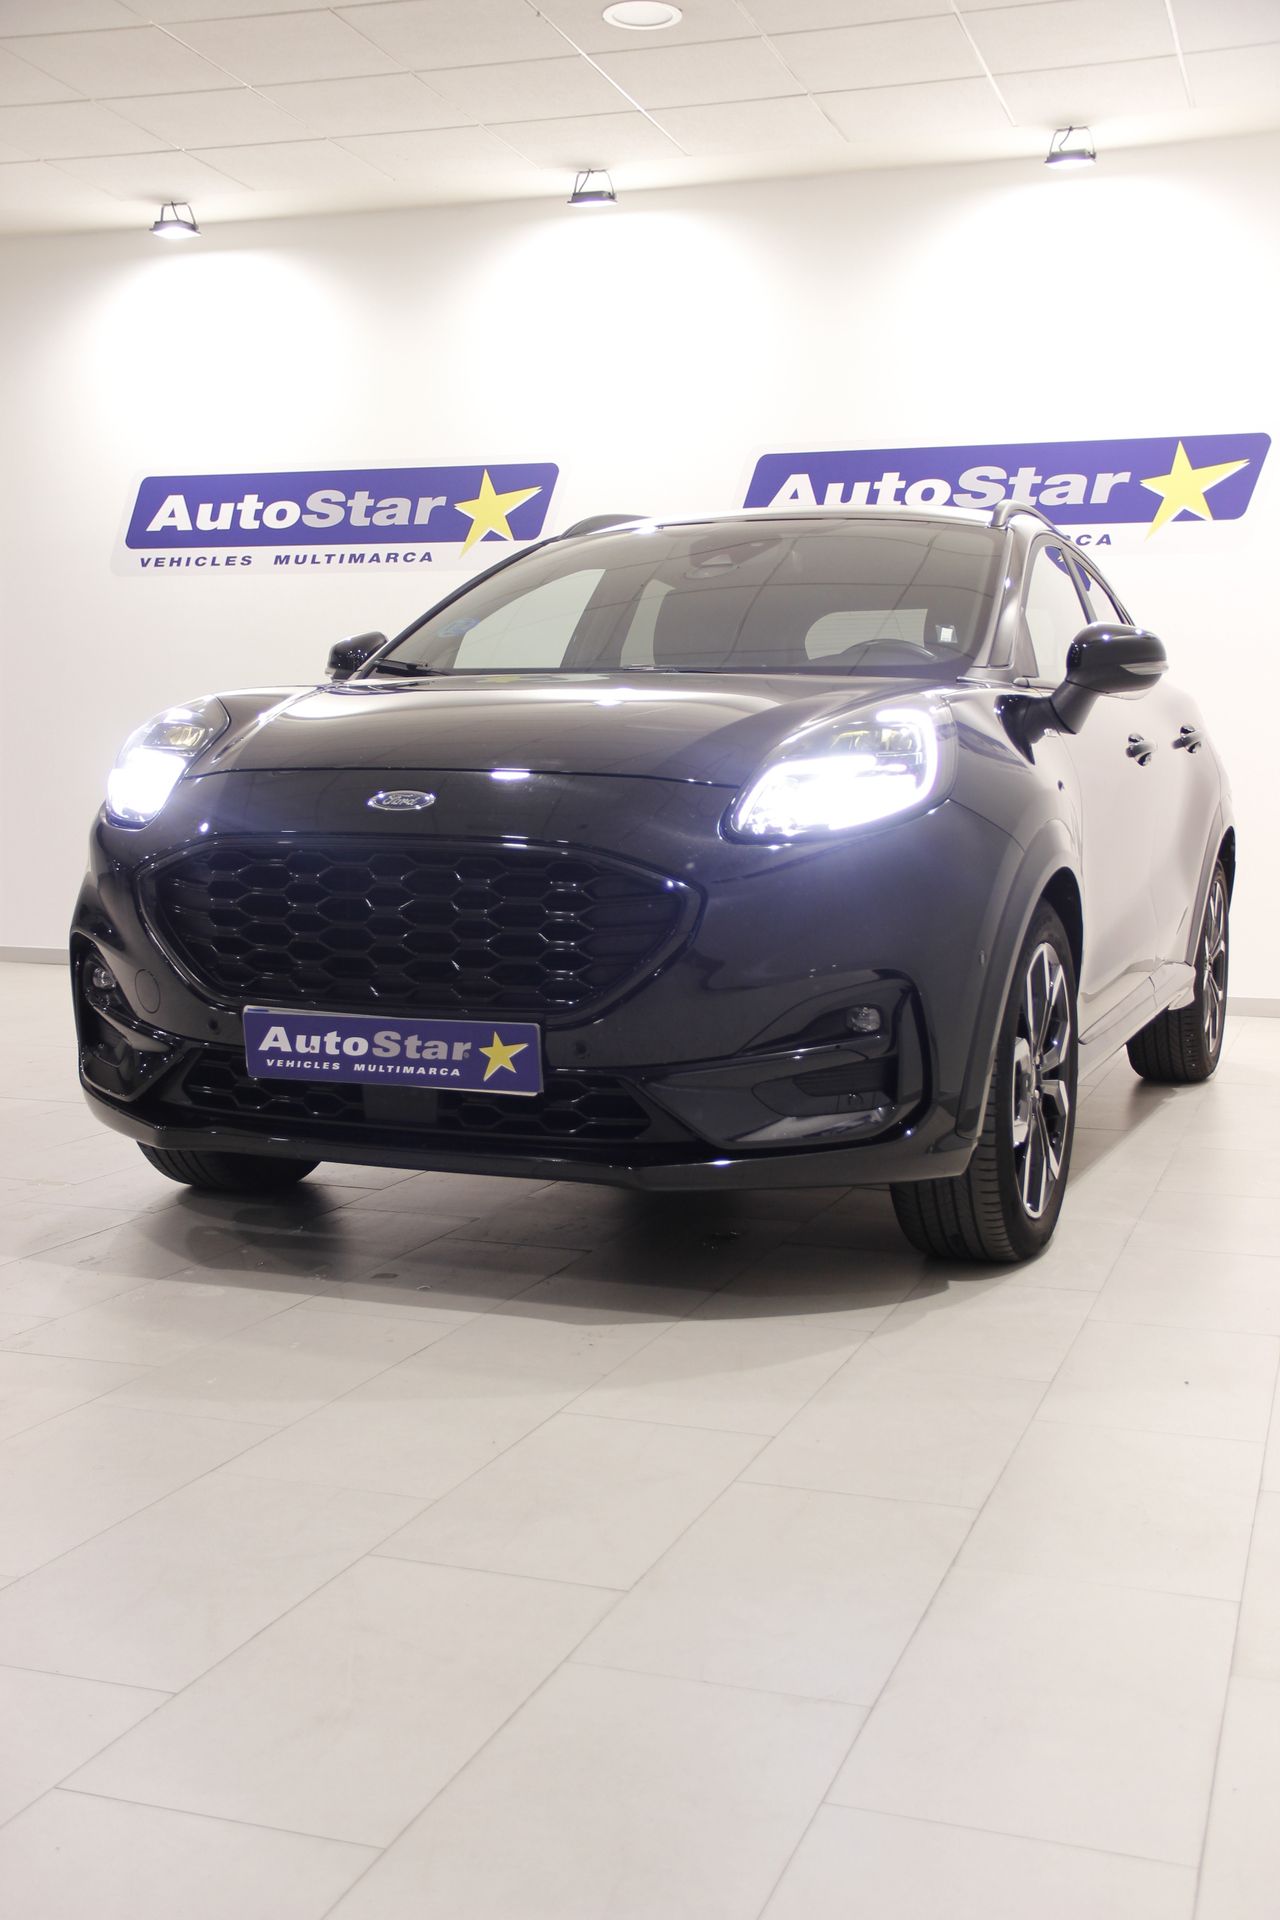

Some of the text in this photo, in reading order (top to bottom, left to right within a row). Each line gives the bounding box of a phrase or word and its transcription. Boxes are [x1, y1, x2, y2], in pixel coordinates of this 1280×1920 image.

[768, 465, 1132, 507] AutoStar
[146, 489, 448, 532] AutoStar
[140, 552, 434, 568] VEHICLES MULTIMARCA
[382, 793, 421, 806] Ford
[258, 1026, 472, 1061] AutoStar
[266, 1058, 461, 1077] VEHICLES MULTIMARCA
